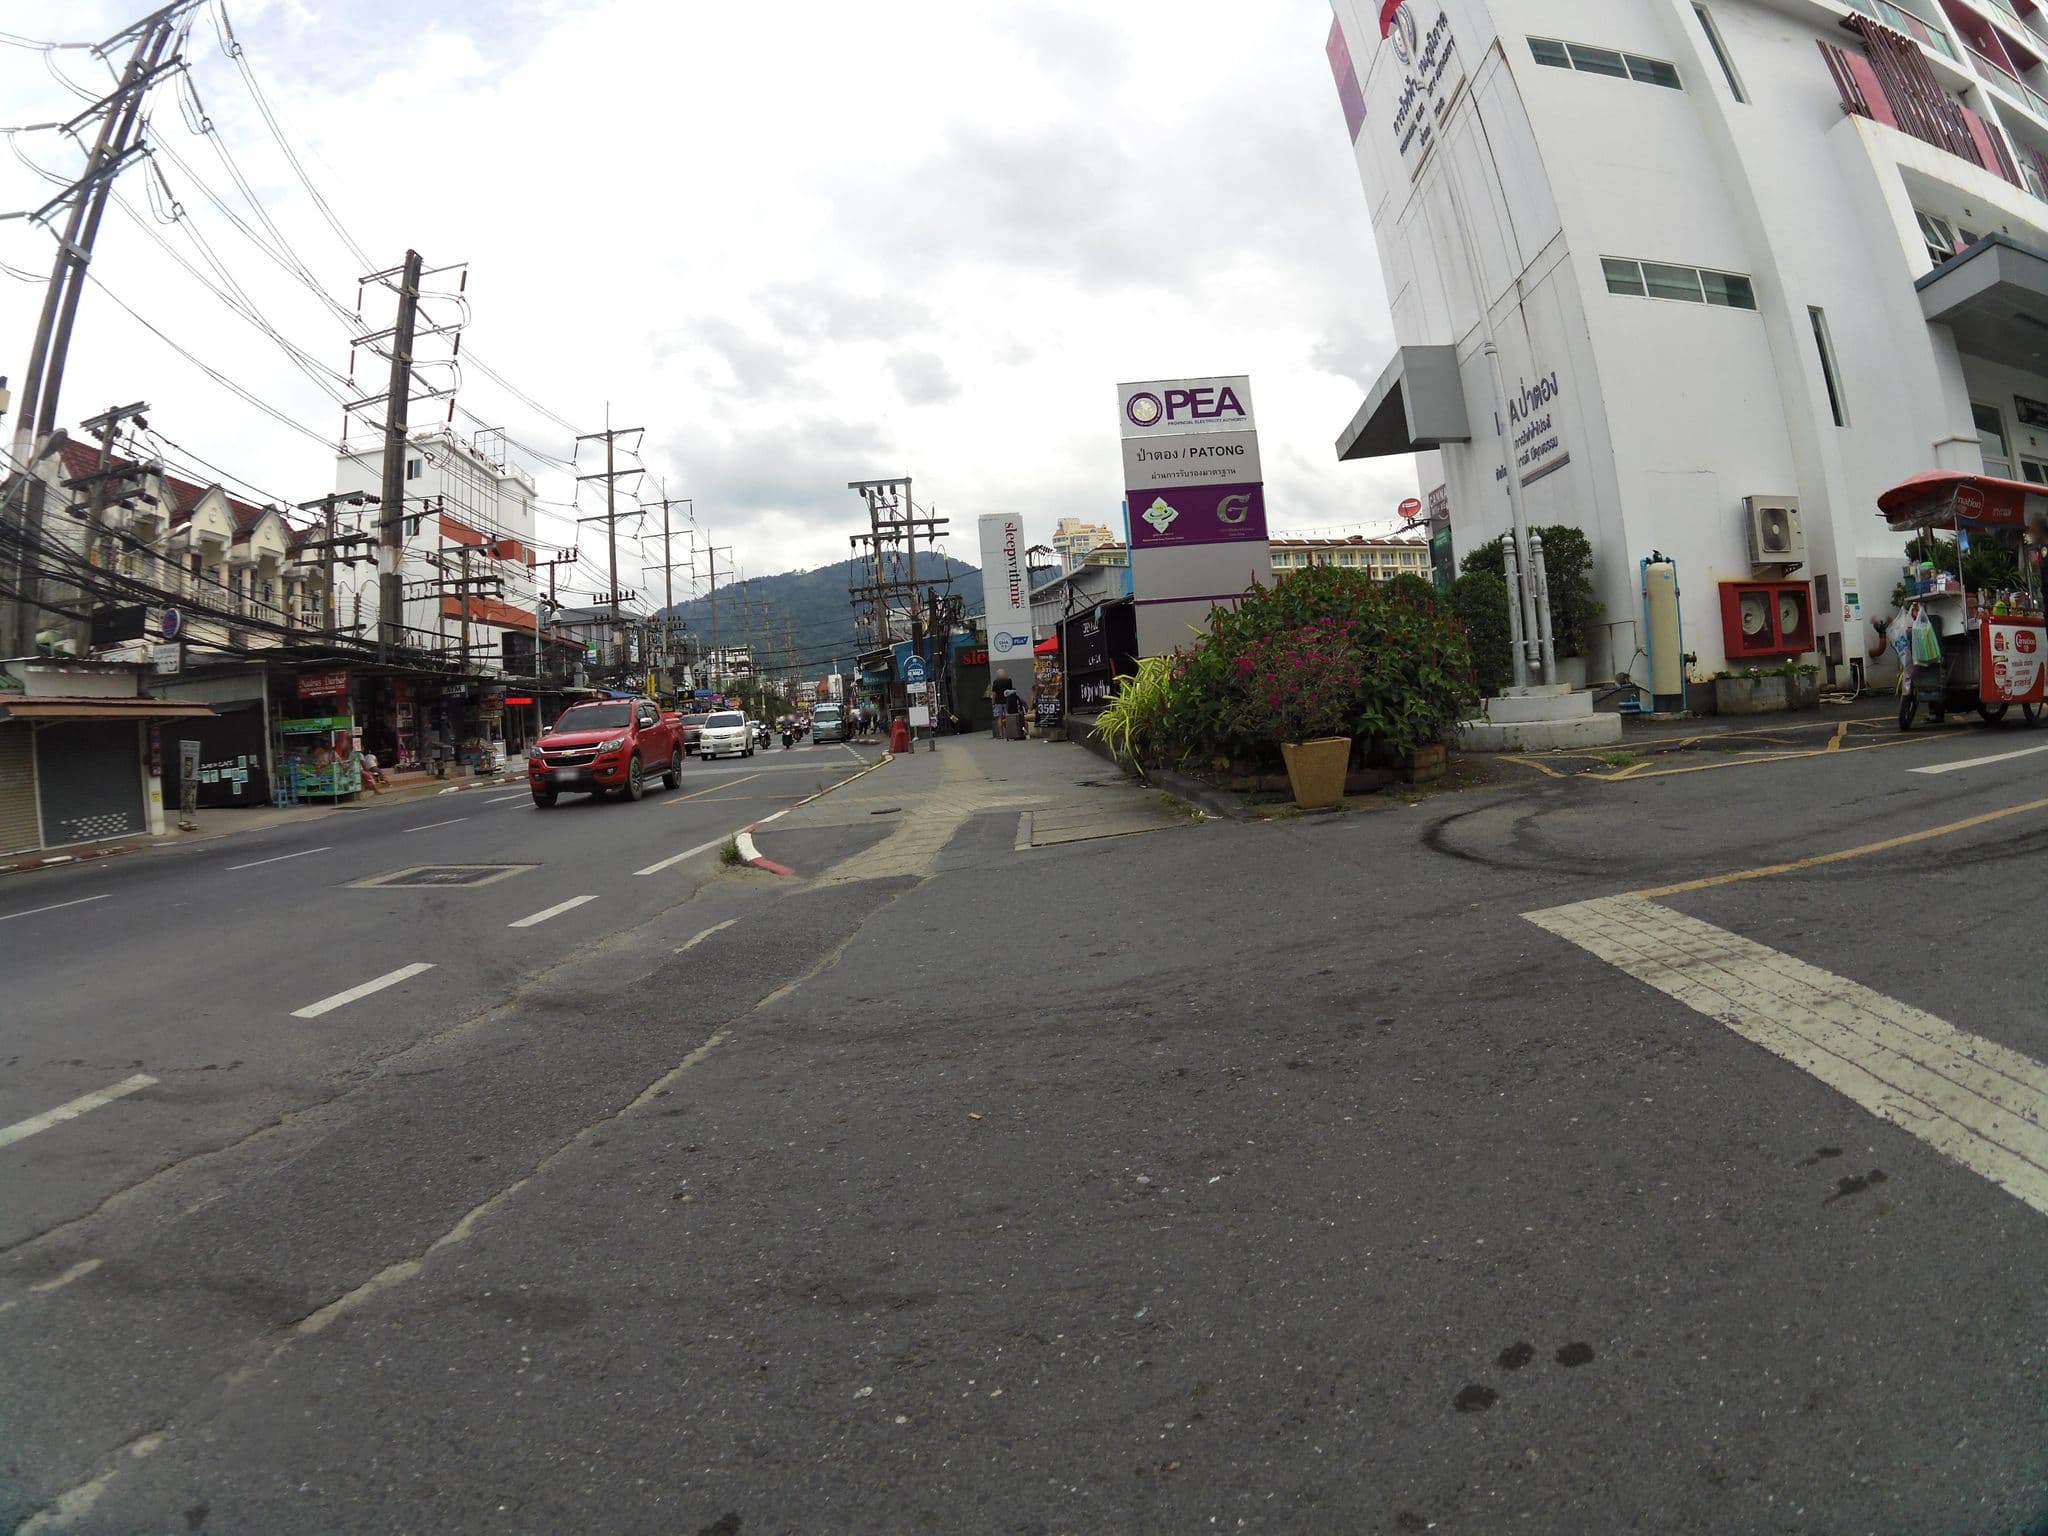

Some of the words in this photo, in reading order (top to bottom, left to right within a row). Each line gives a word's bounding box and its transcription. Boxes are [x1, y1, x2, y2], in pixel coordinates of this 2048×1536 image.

[1164, 387, 1246, 420] PEA
[1137, 448, 1178, 461] ป่าตอง
[1190, 445, 1244, 458] PATONG
[1003, 522, 1022, 609] sleepwithme
